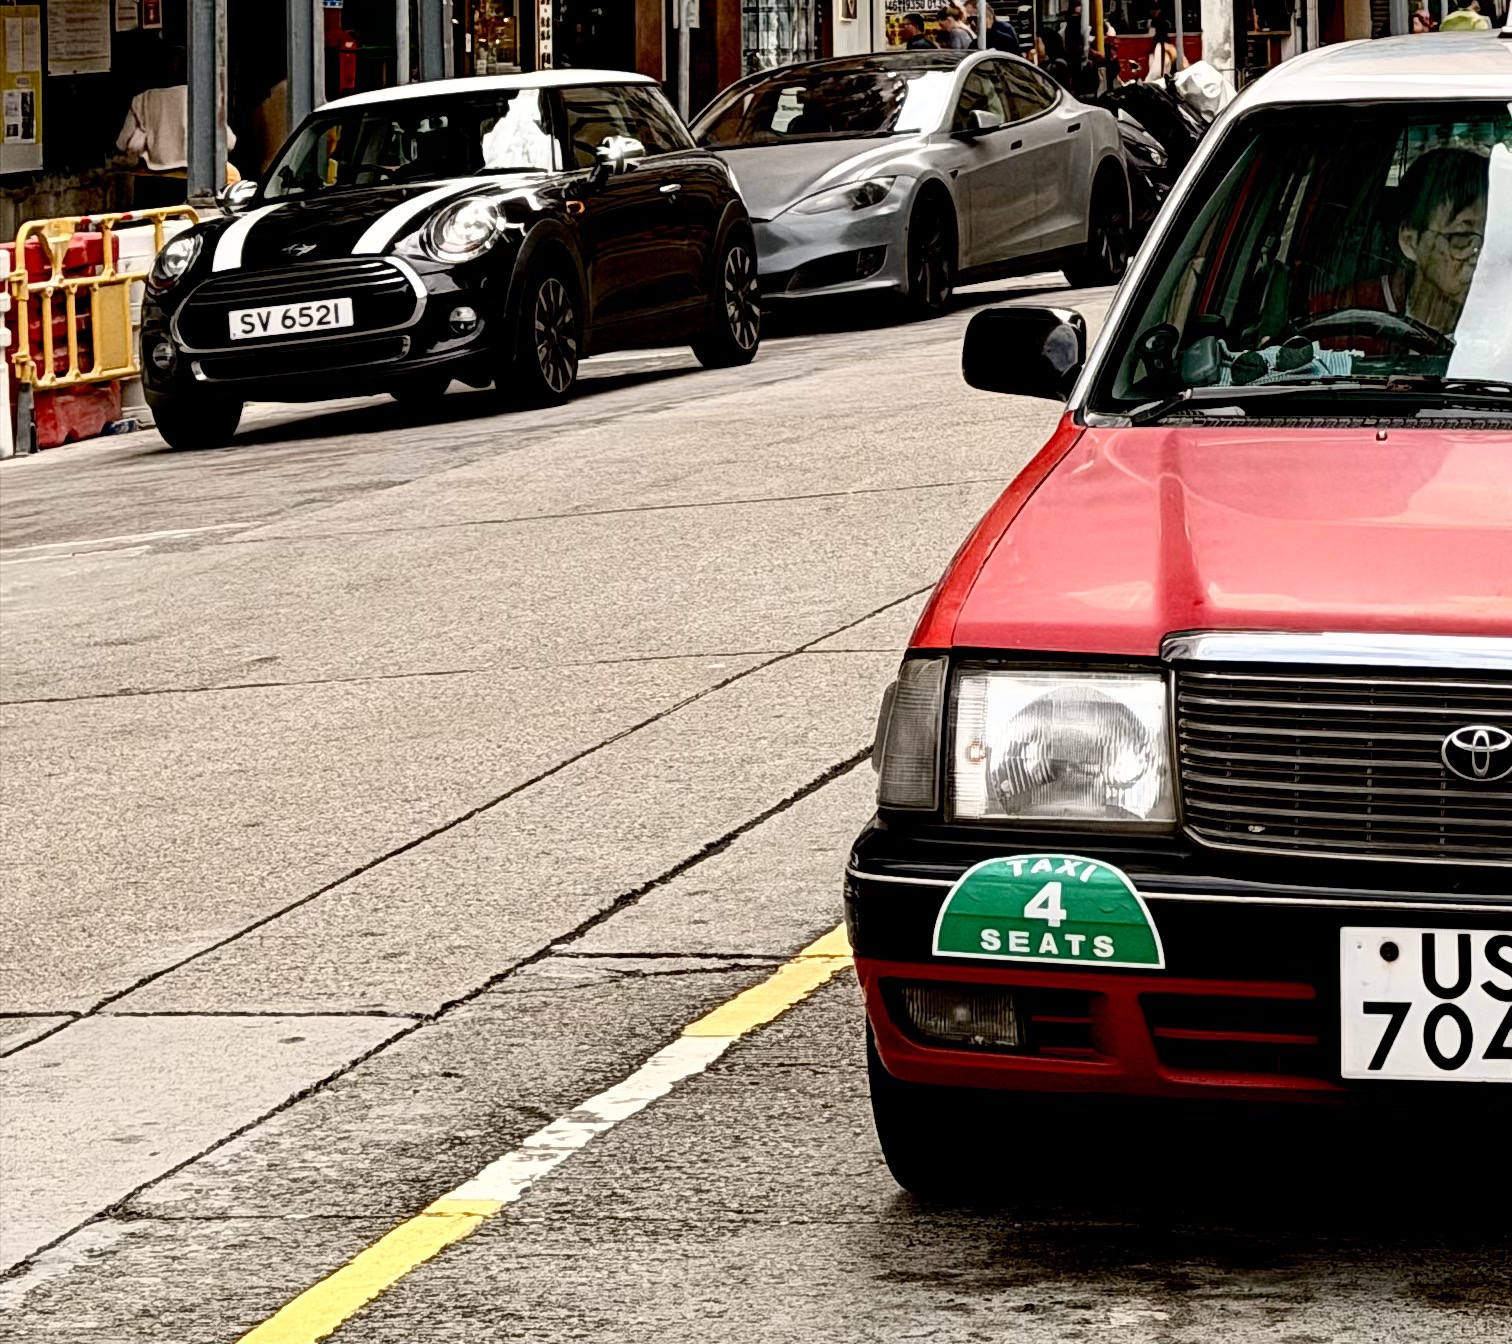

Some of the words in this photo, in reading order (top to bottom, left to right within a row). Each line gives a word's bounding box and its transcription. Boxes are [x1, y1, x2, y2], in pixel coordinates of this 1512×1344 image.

[240, 311, 271, 334] SV
[281, 303, 340, 329] 6521
[1006, 858, 1097, 883] TAXI
[1024, 881, 1067, 928] 4
[980, 928, 1115, 958] SEATS
